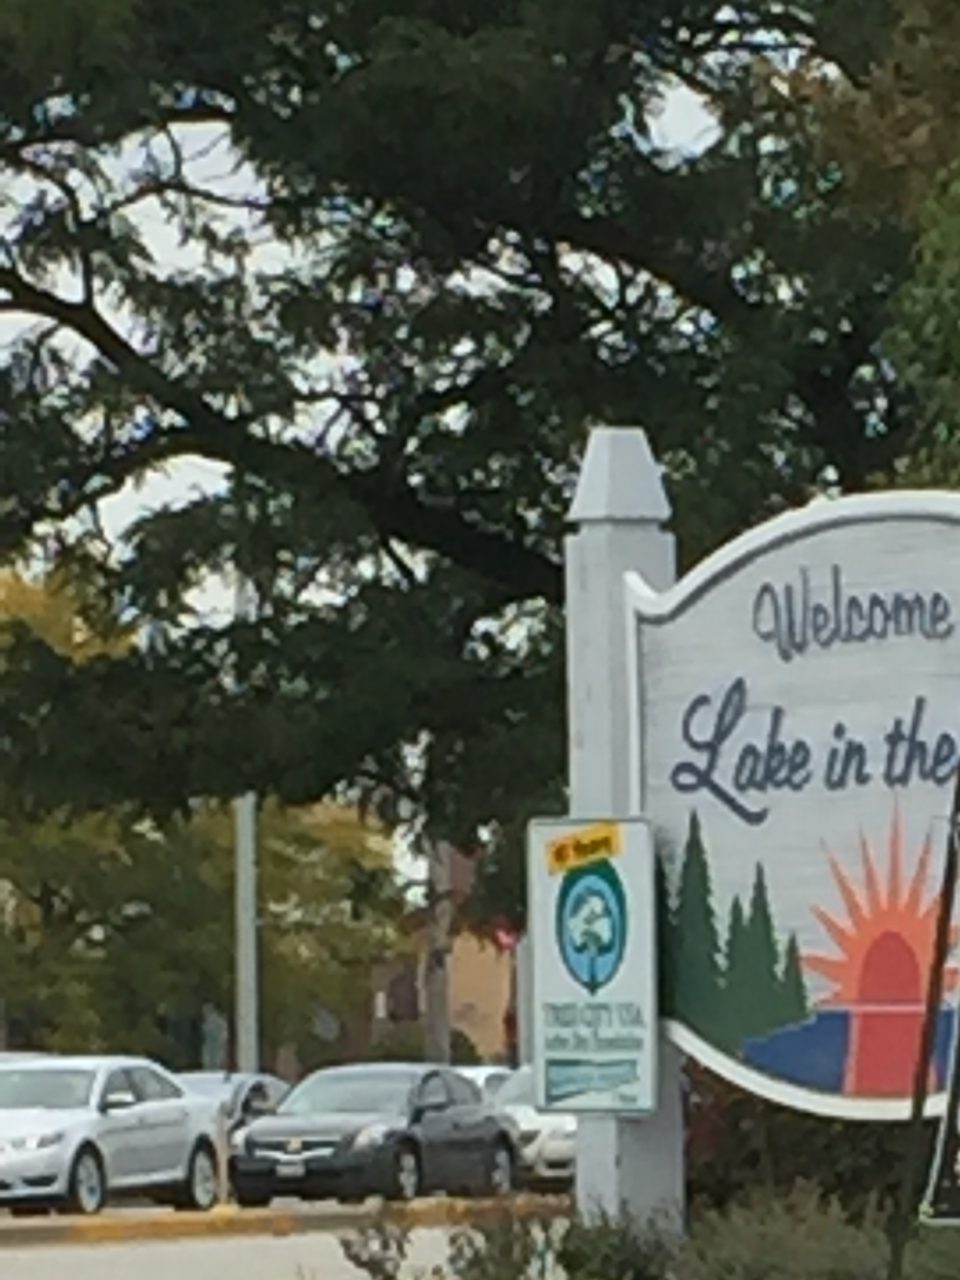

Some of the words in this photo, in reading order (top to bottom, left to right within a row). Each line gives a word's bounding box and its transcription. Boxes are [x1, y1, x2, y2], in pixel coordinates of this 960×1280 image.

[752, 564, 954, 662] Welcome
[670, 677, 813, 825] Lake
[823, 722, 872, 790] in
[884, 697, 960, 788] the
